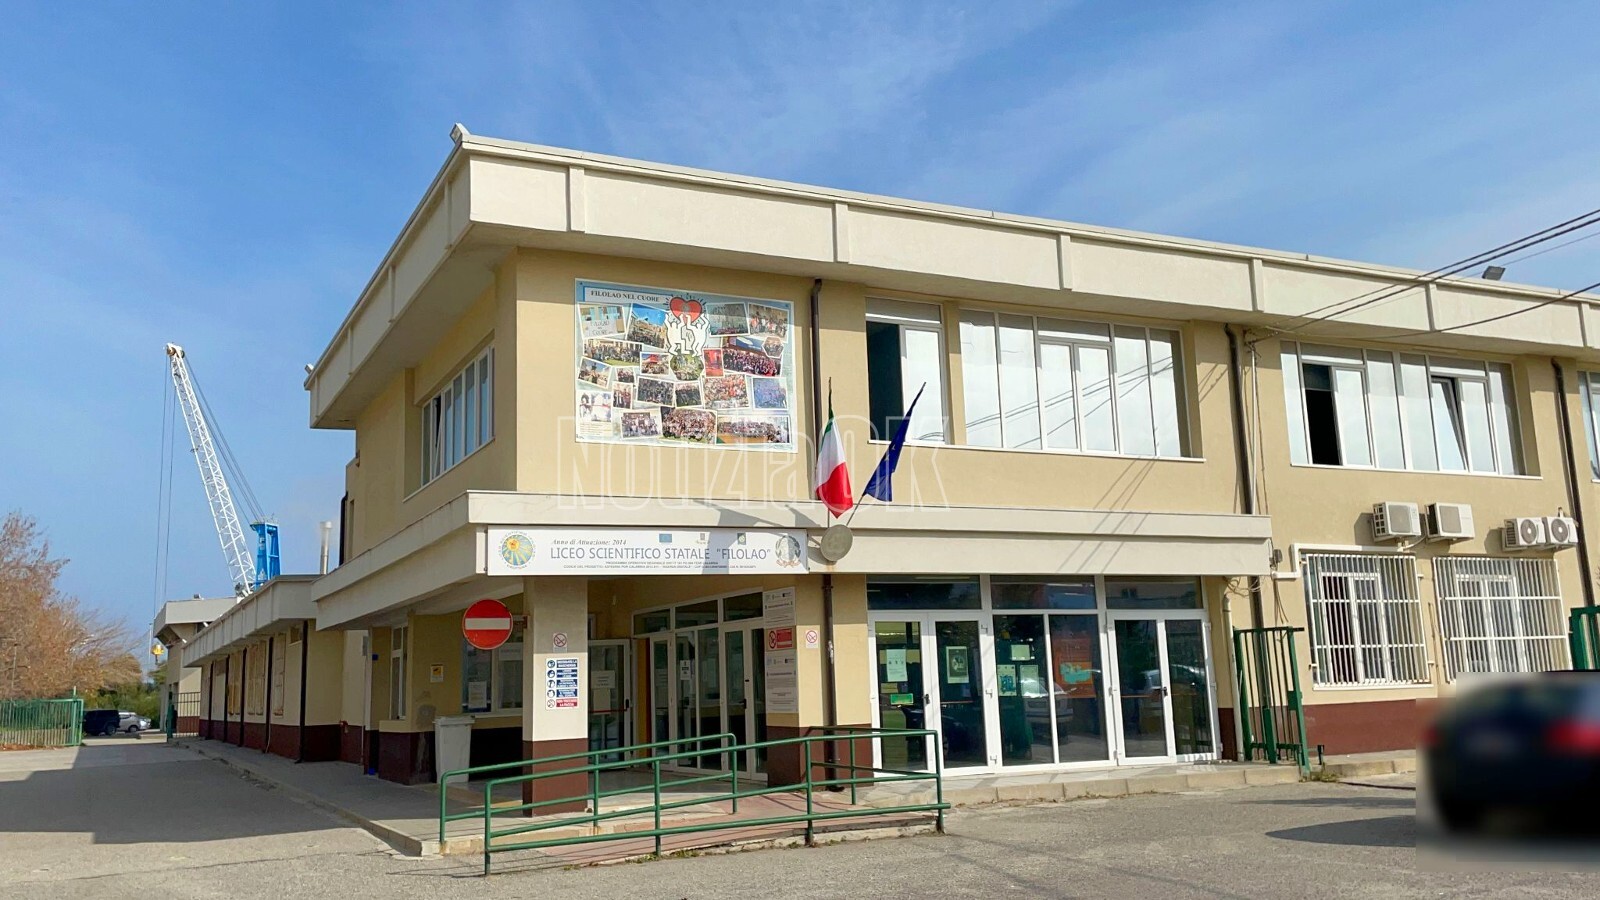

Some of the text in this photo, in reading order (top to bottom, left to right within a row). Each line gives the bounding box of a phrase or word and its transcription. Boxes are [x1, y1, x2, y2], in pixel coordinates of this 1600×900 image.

[591, 290, 621, 298] FILOLAO
[637, 294, 660, 302] CUORE
[550, 547, 771, 560] LICEO SCIENTIFICO STATALE "FILOLAO"
